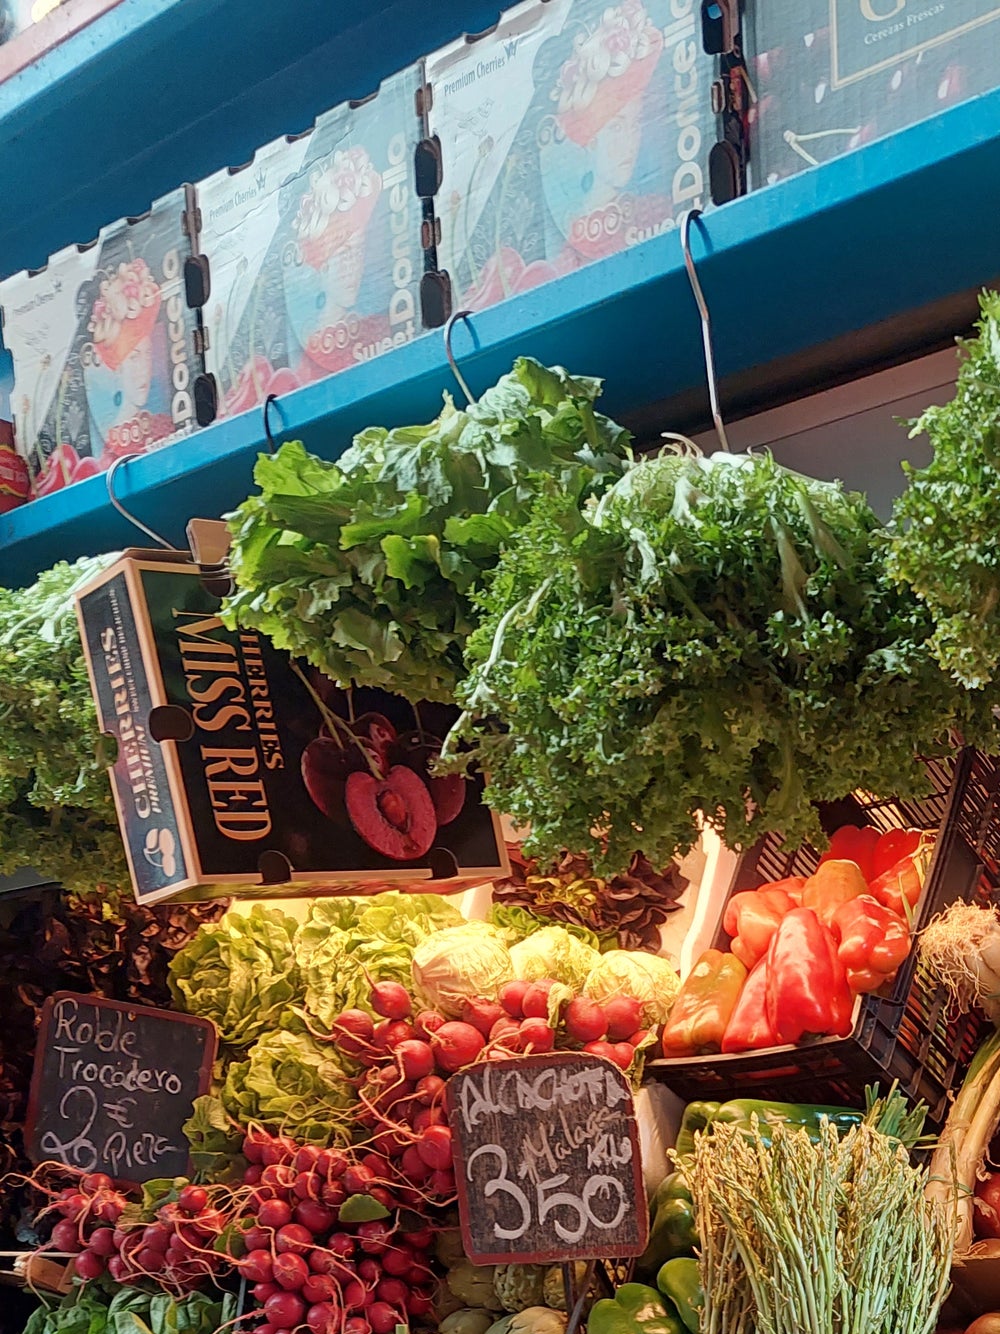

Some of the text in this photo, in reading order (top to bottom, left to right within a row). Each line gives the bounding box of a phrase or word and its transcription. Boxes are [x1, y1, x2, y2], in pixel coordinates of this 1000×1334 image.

[444, 54, 506, 97] Premium Cherries
[864, 22, 905, 45] Cerezas
[906, 3, 946, 27] Frescas
[382, 131, 416, 327] Doncella
[101, 626, 151, 819] CHERRIES
[171, 608, 273, 840] MISS RED
[239, 625, 285, 770] HERRIES
